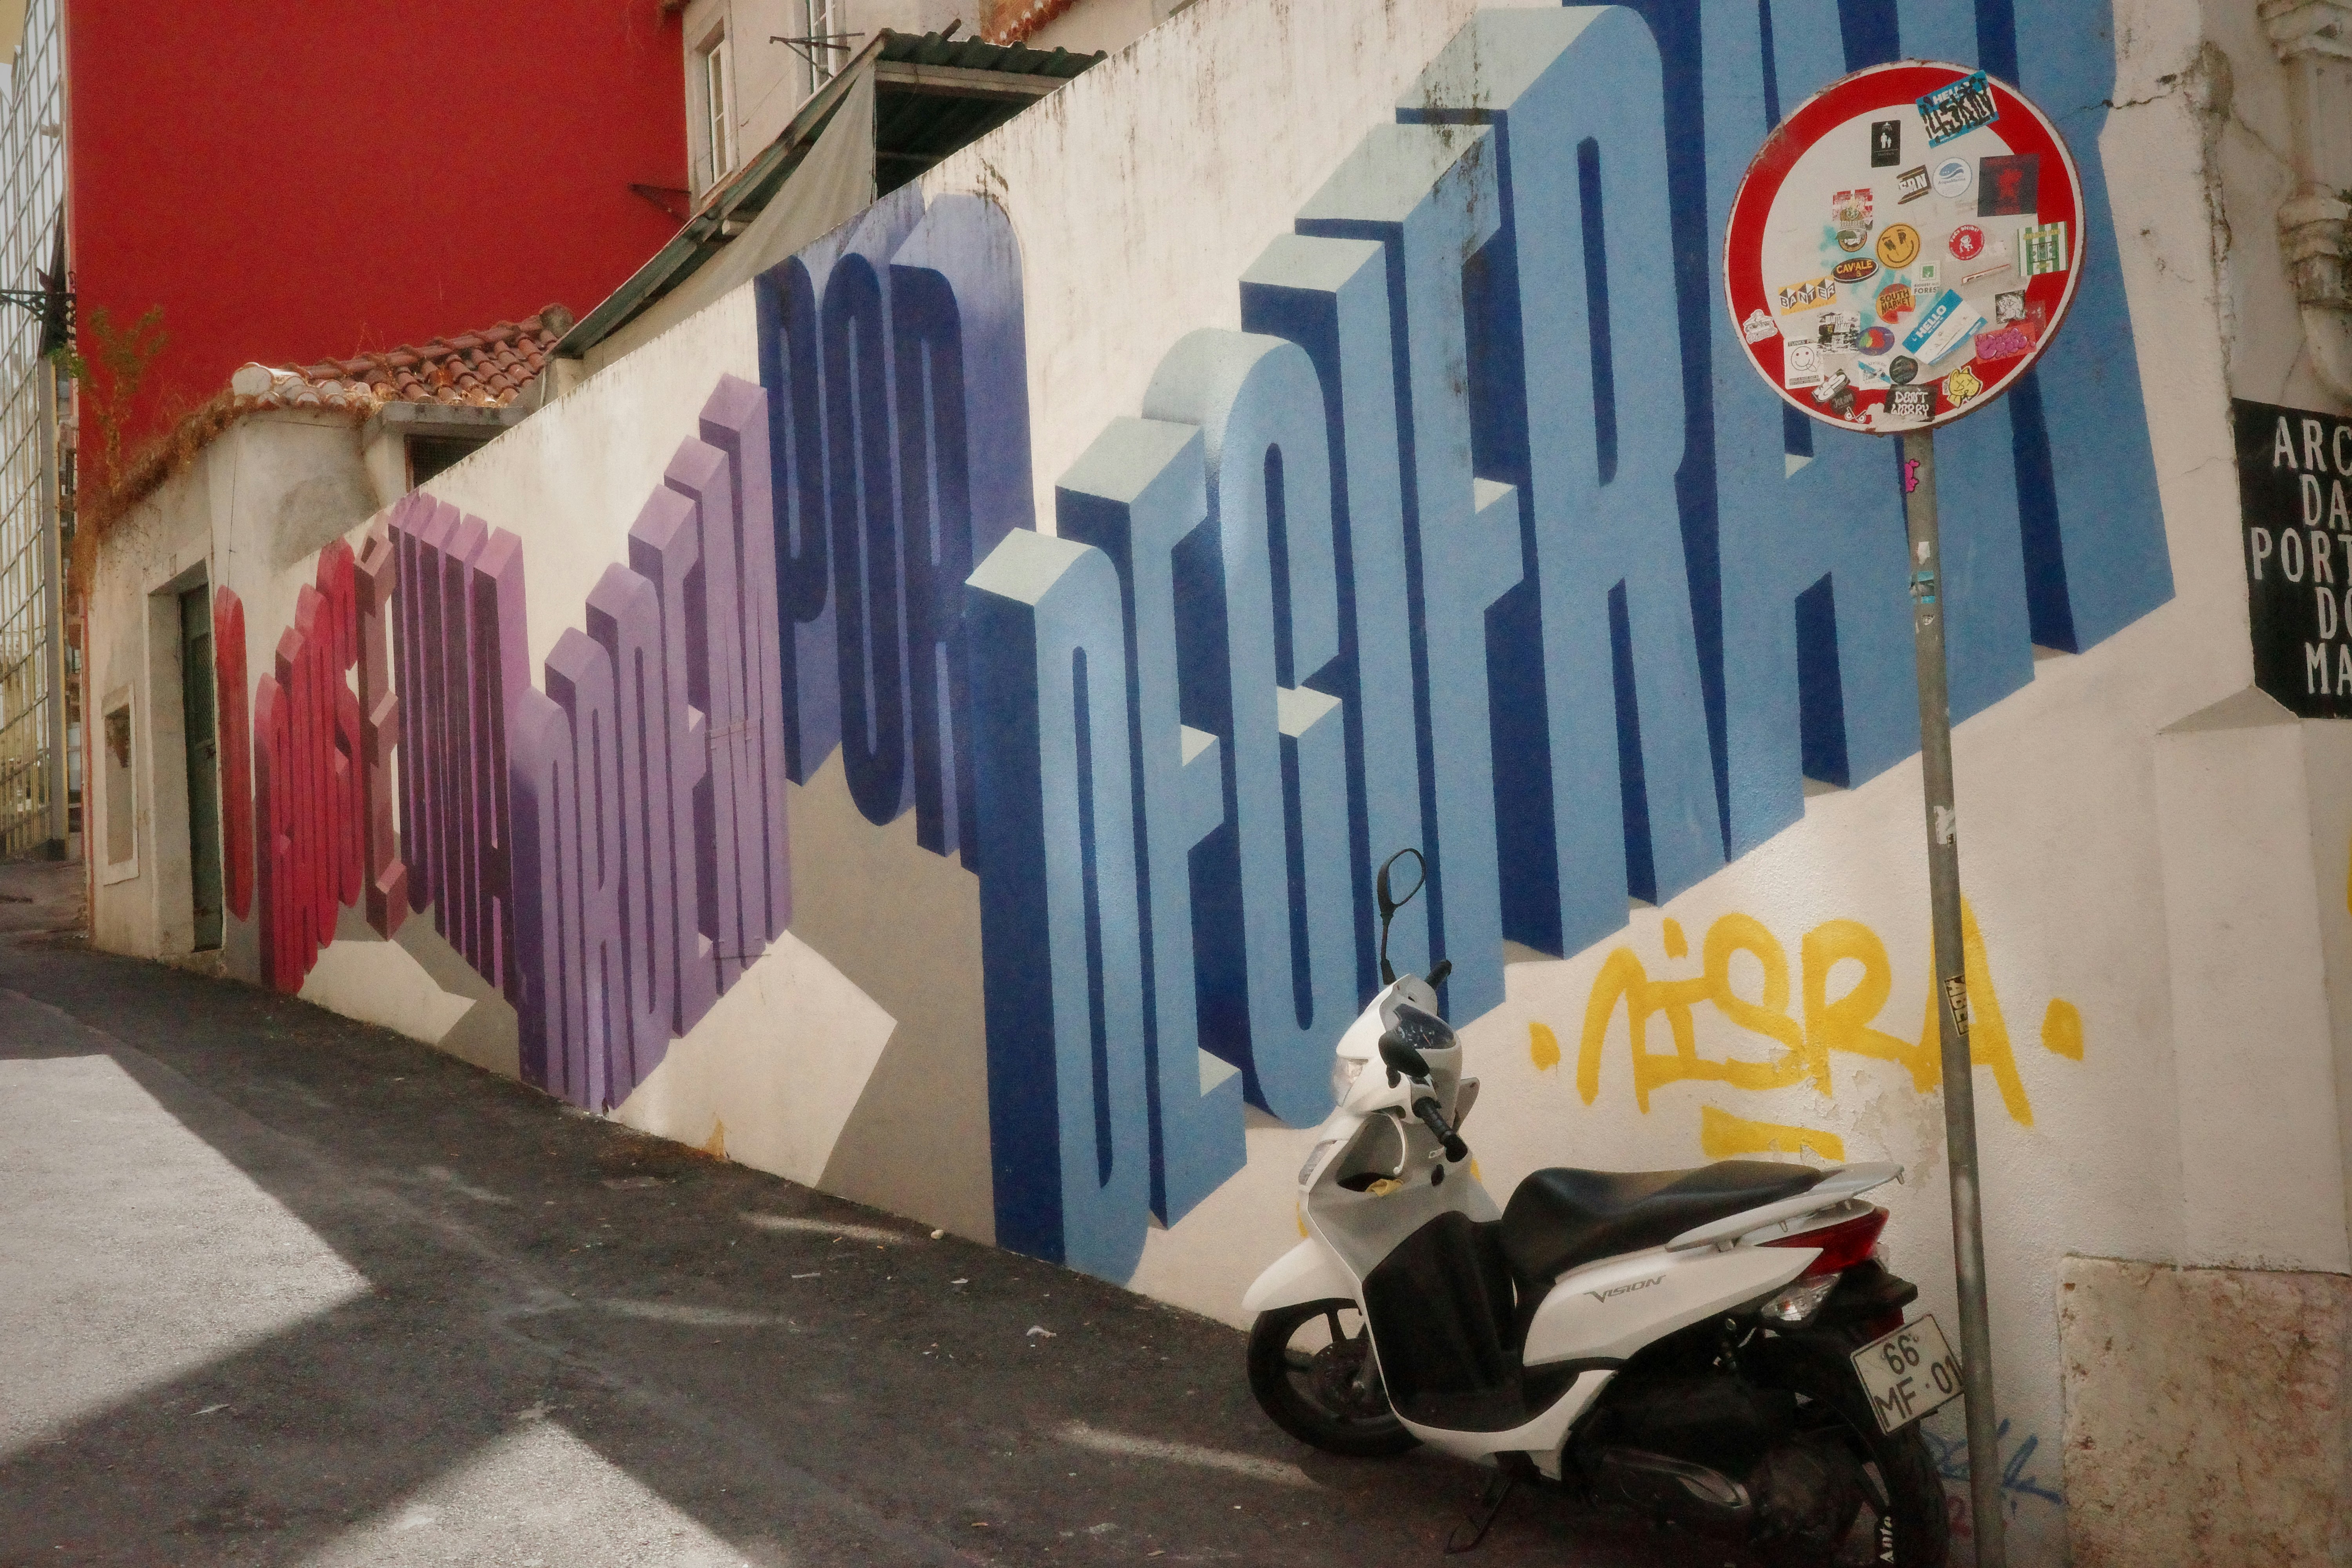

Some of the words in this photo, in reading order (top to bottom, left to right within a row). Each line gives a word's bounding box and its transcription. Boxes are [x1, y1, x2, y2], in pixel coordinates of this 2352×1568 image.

[1836, 260, 1873, 274] CAV'ALE
[1780, 284, 1836, 307] BANTER
[1880, 289, 1909, 304] SOUTH
[1881, 296, 1911, 315] MARKET
[1916, 305, 1947, 339] HELLO
[1895, 388, 1929, 404] DON'T
[1891, 404, 1929, 416] WORRY
[510, 374, 792, 1112] ORDEM
[755, 178, 1036, 877] POR
[965, 0, 2174, 1281] DECIFRAR
[1583, 1274, 1666, 1303] VISION
[1883, 1334, 1920, 1375] 66
